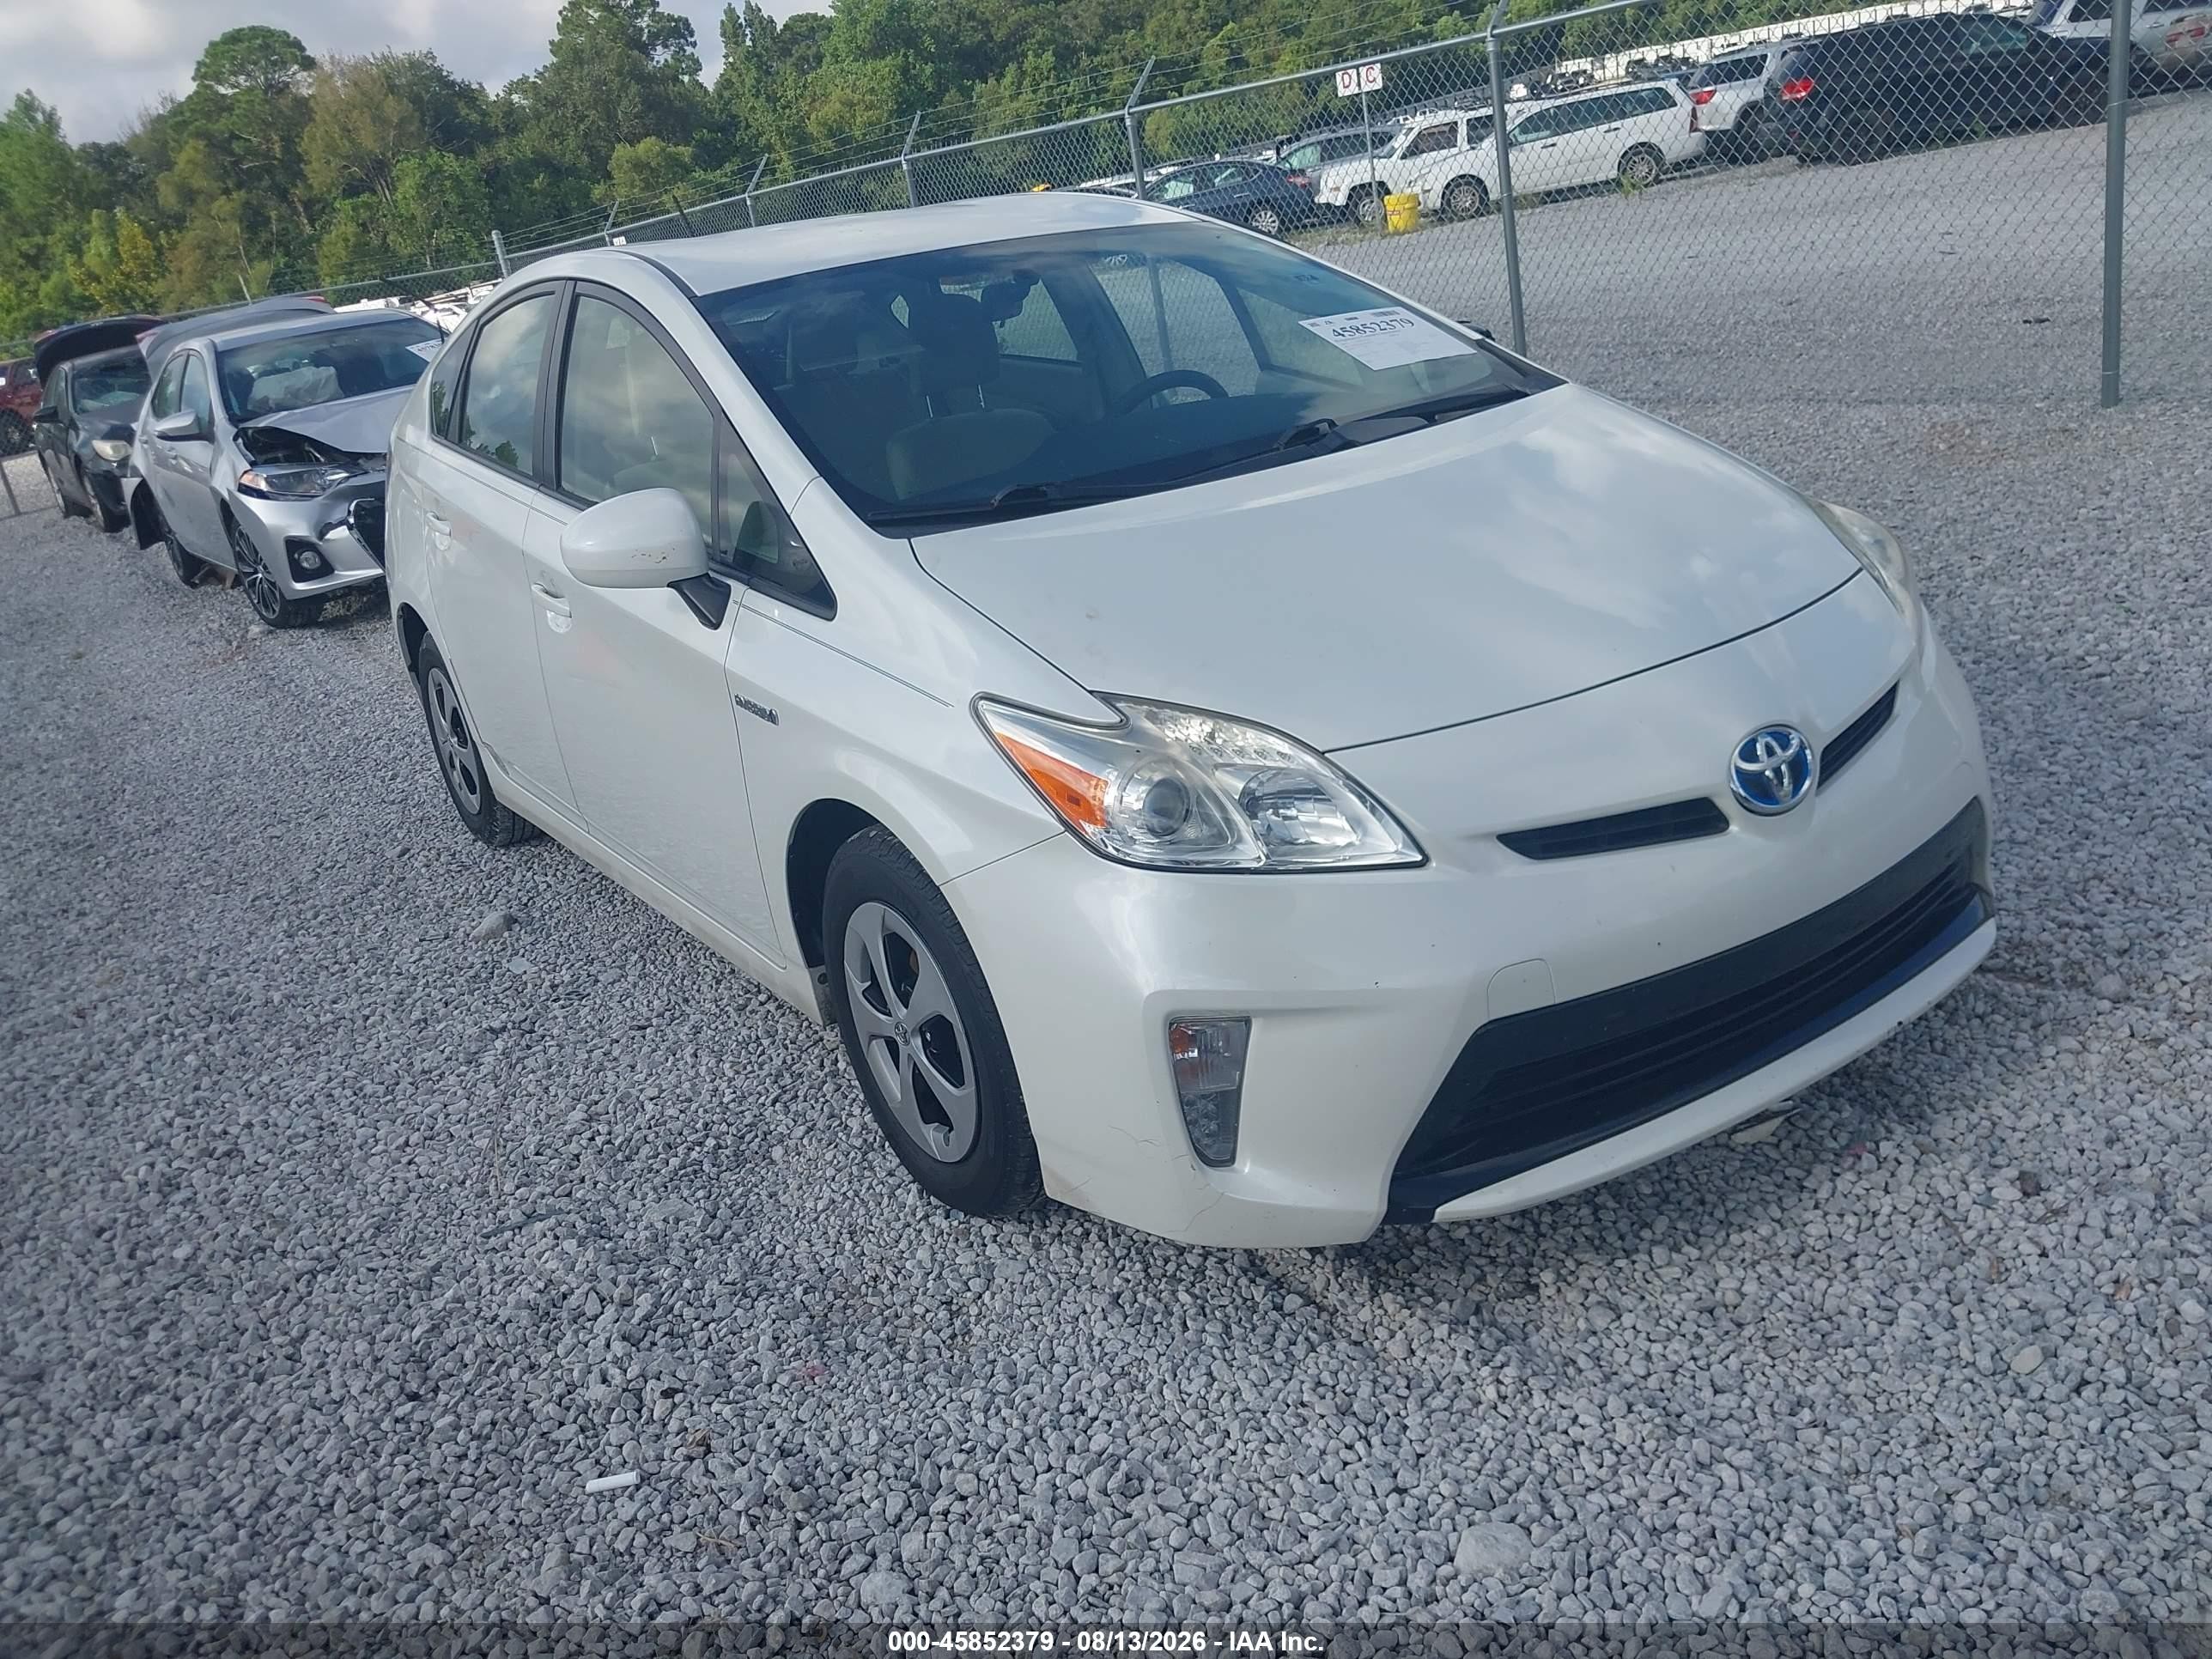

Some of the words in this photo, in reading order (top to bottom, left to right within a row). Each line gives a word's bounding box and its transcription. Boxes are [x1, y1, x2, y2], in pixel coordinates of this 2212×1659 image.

[1341, 71, 1352, 88] D
[1366, 66, 1376, 83] C
[1332, 318, 1415, 338] 45852379
